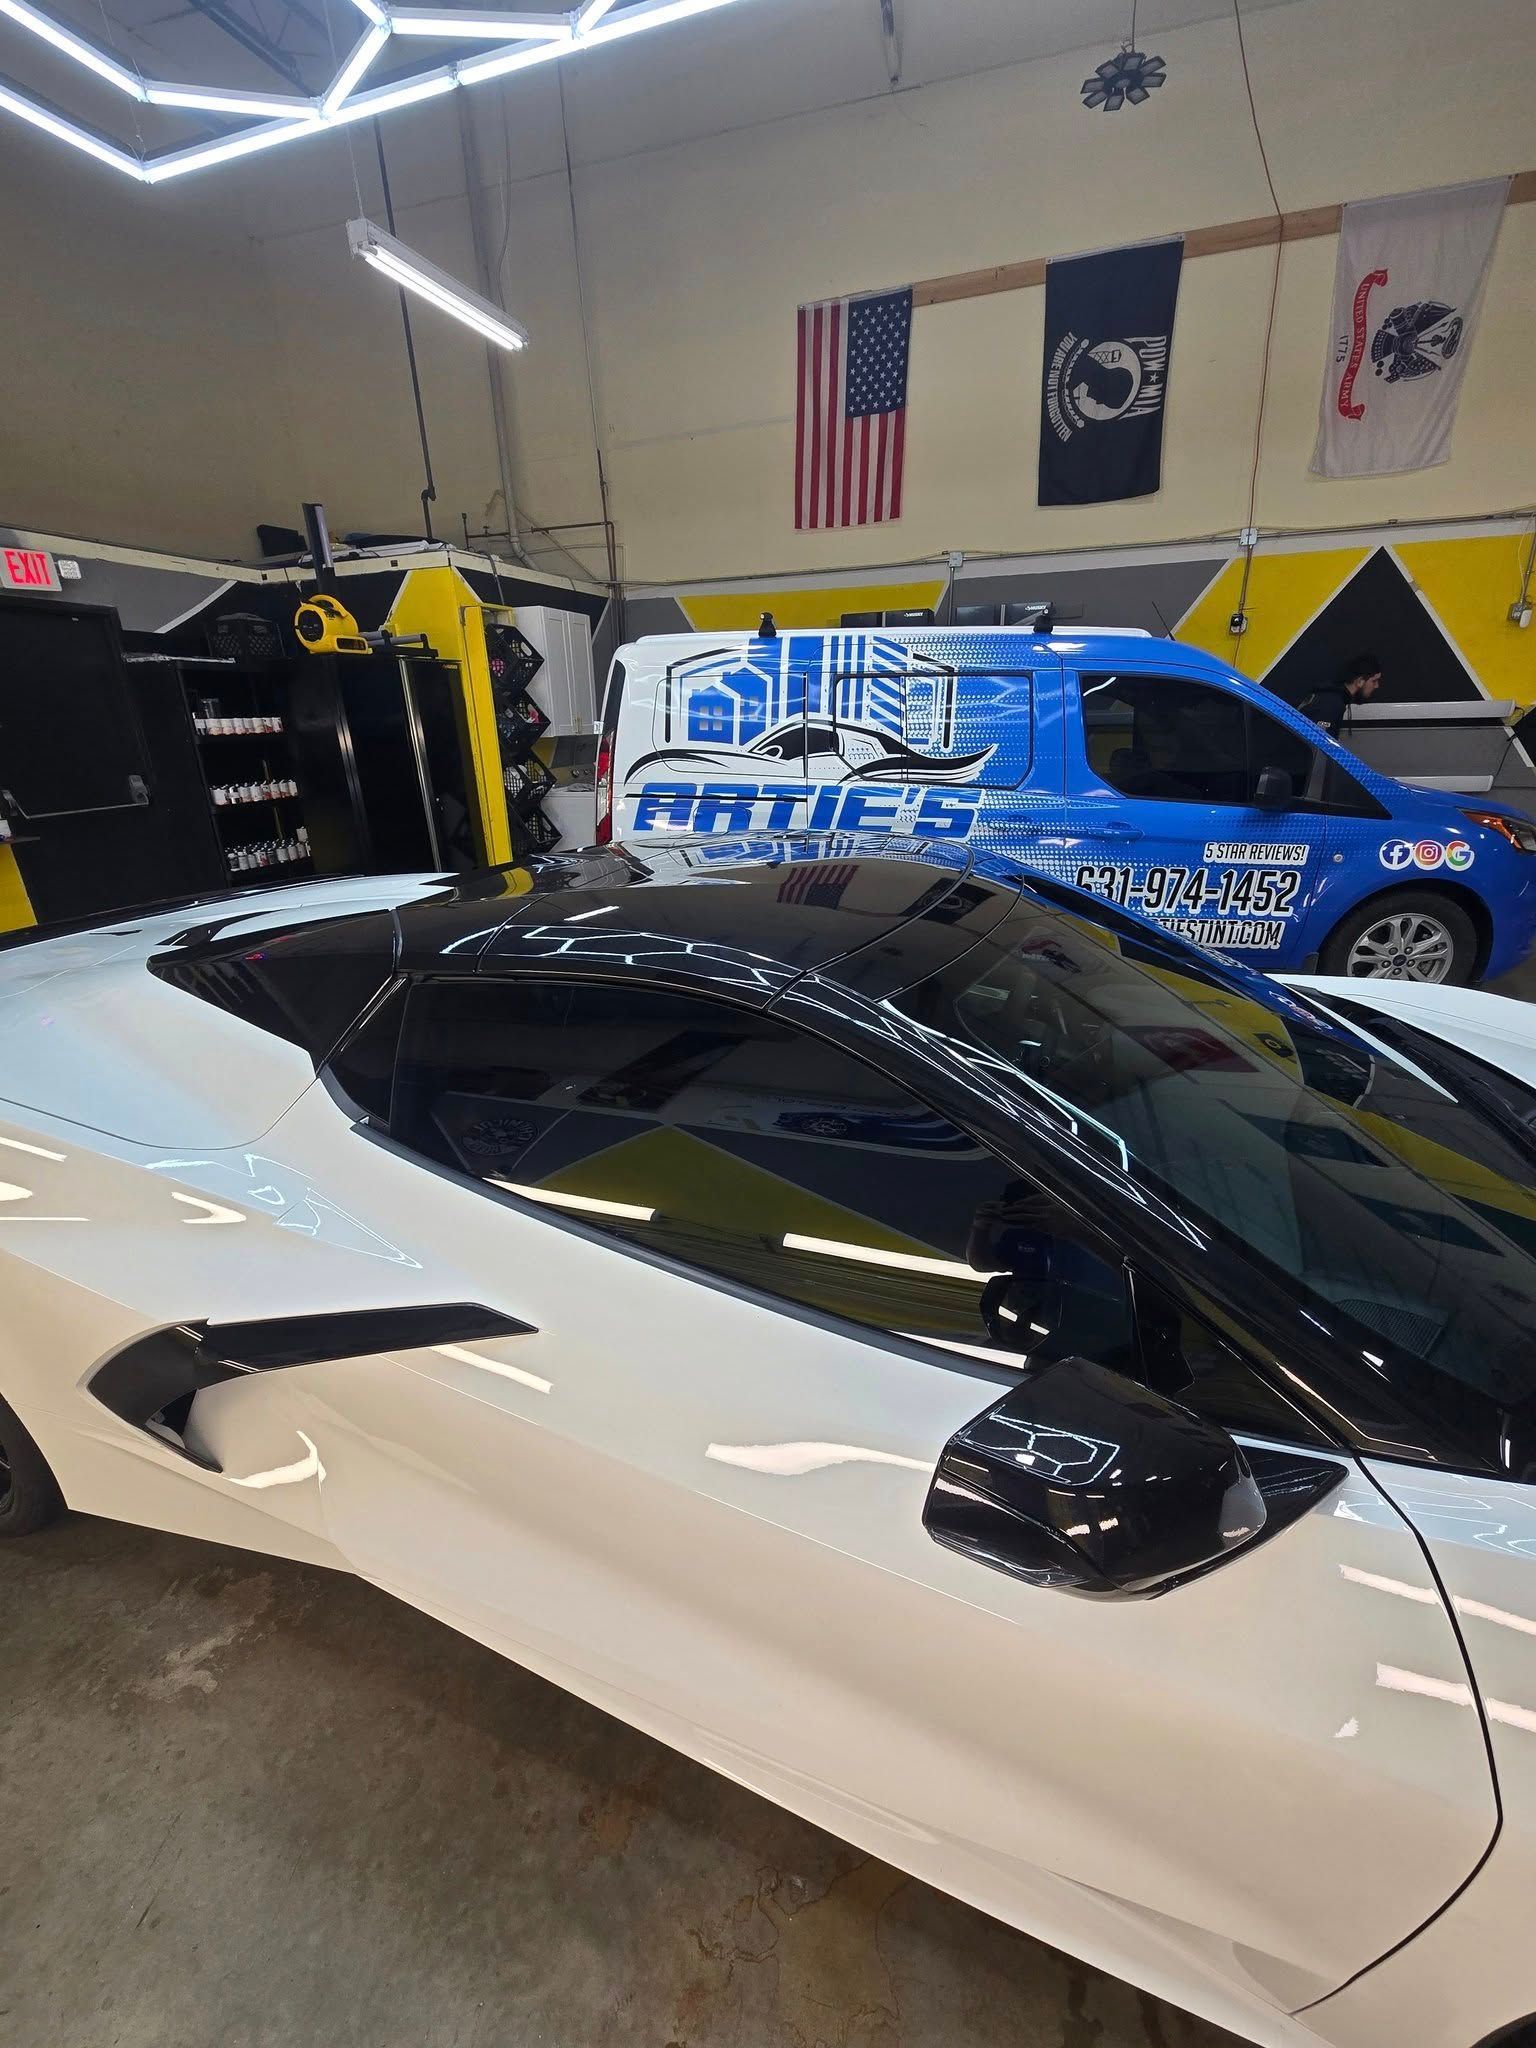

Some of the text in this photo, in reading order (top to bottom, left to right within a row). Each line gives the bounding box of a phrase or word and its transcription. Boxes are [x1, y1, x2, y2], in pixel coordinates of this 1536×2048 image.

[1336, 335, 1349, 363] 1775
[1340, 283, 1370, 408] UNITED STATES ARMY
[1047, 332, 1078, 442] YOU ARE NOT FORGOTTEN
[1118, 336, 1167, 420] POW MIA
[4, 550, 51, 585] EXIT
[632, 782, 987, 840] ARTIE'S
[1205, 843, 1306, 862] 5 STAR REVIEWS!
[1076, 866, 1298, 912] 631-974-1452
